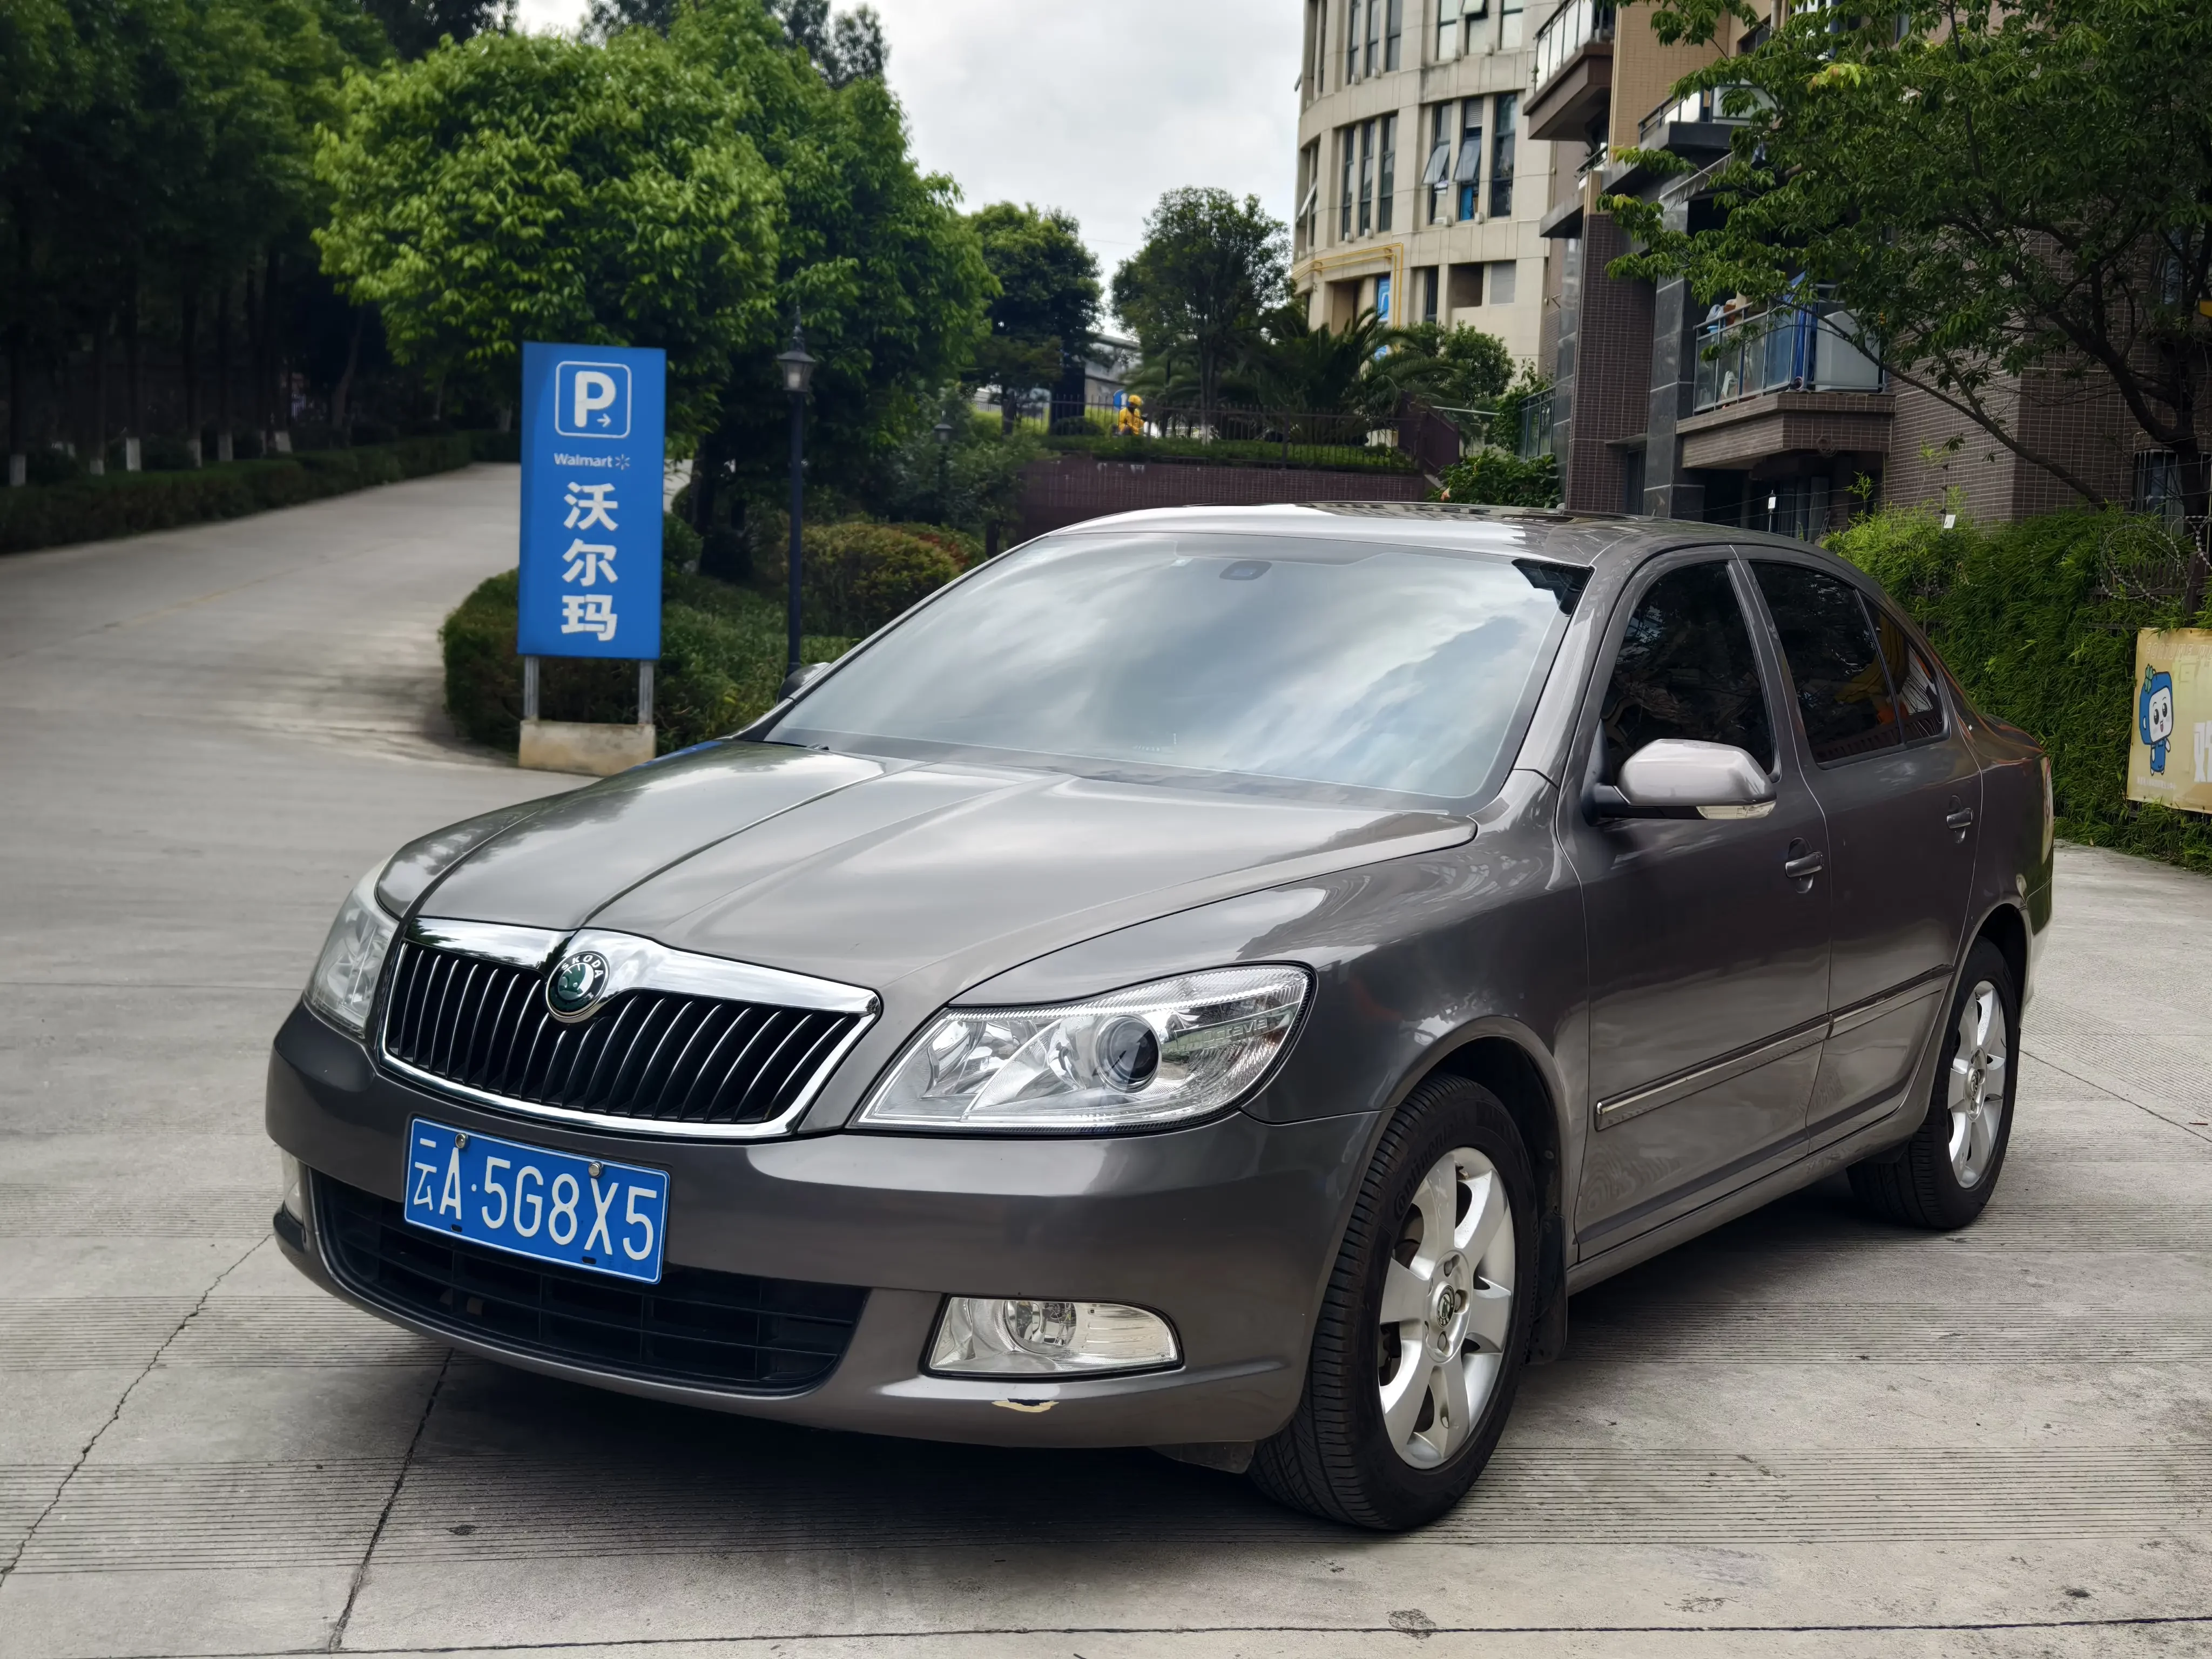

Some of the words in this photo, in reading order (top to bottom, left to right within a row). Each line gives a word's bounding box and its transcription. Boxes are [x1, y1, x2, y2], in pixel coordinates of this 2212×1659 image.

[574, 370, 617, 428] P
[554, 453, 613, 468] Walmart
[561, 481, 619, 642] 沃尔玛
